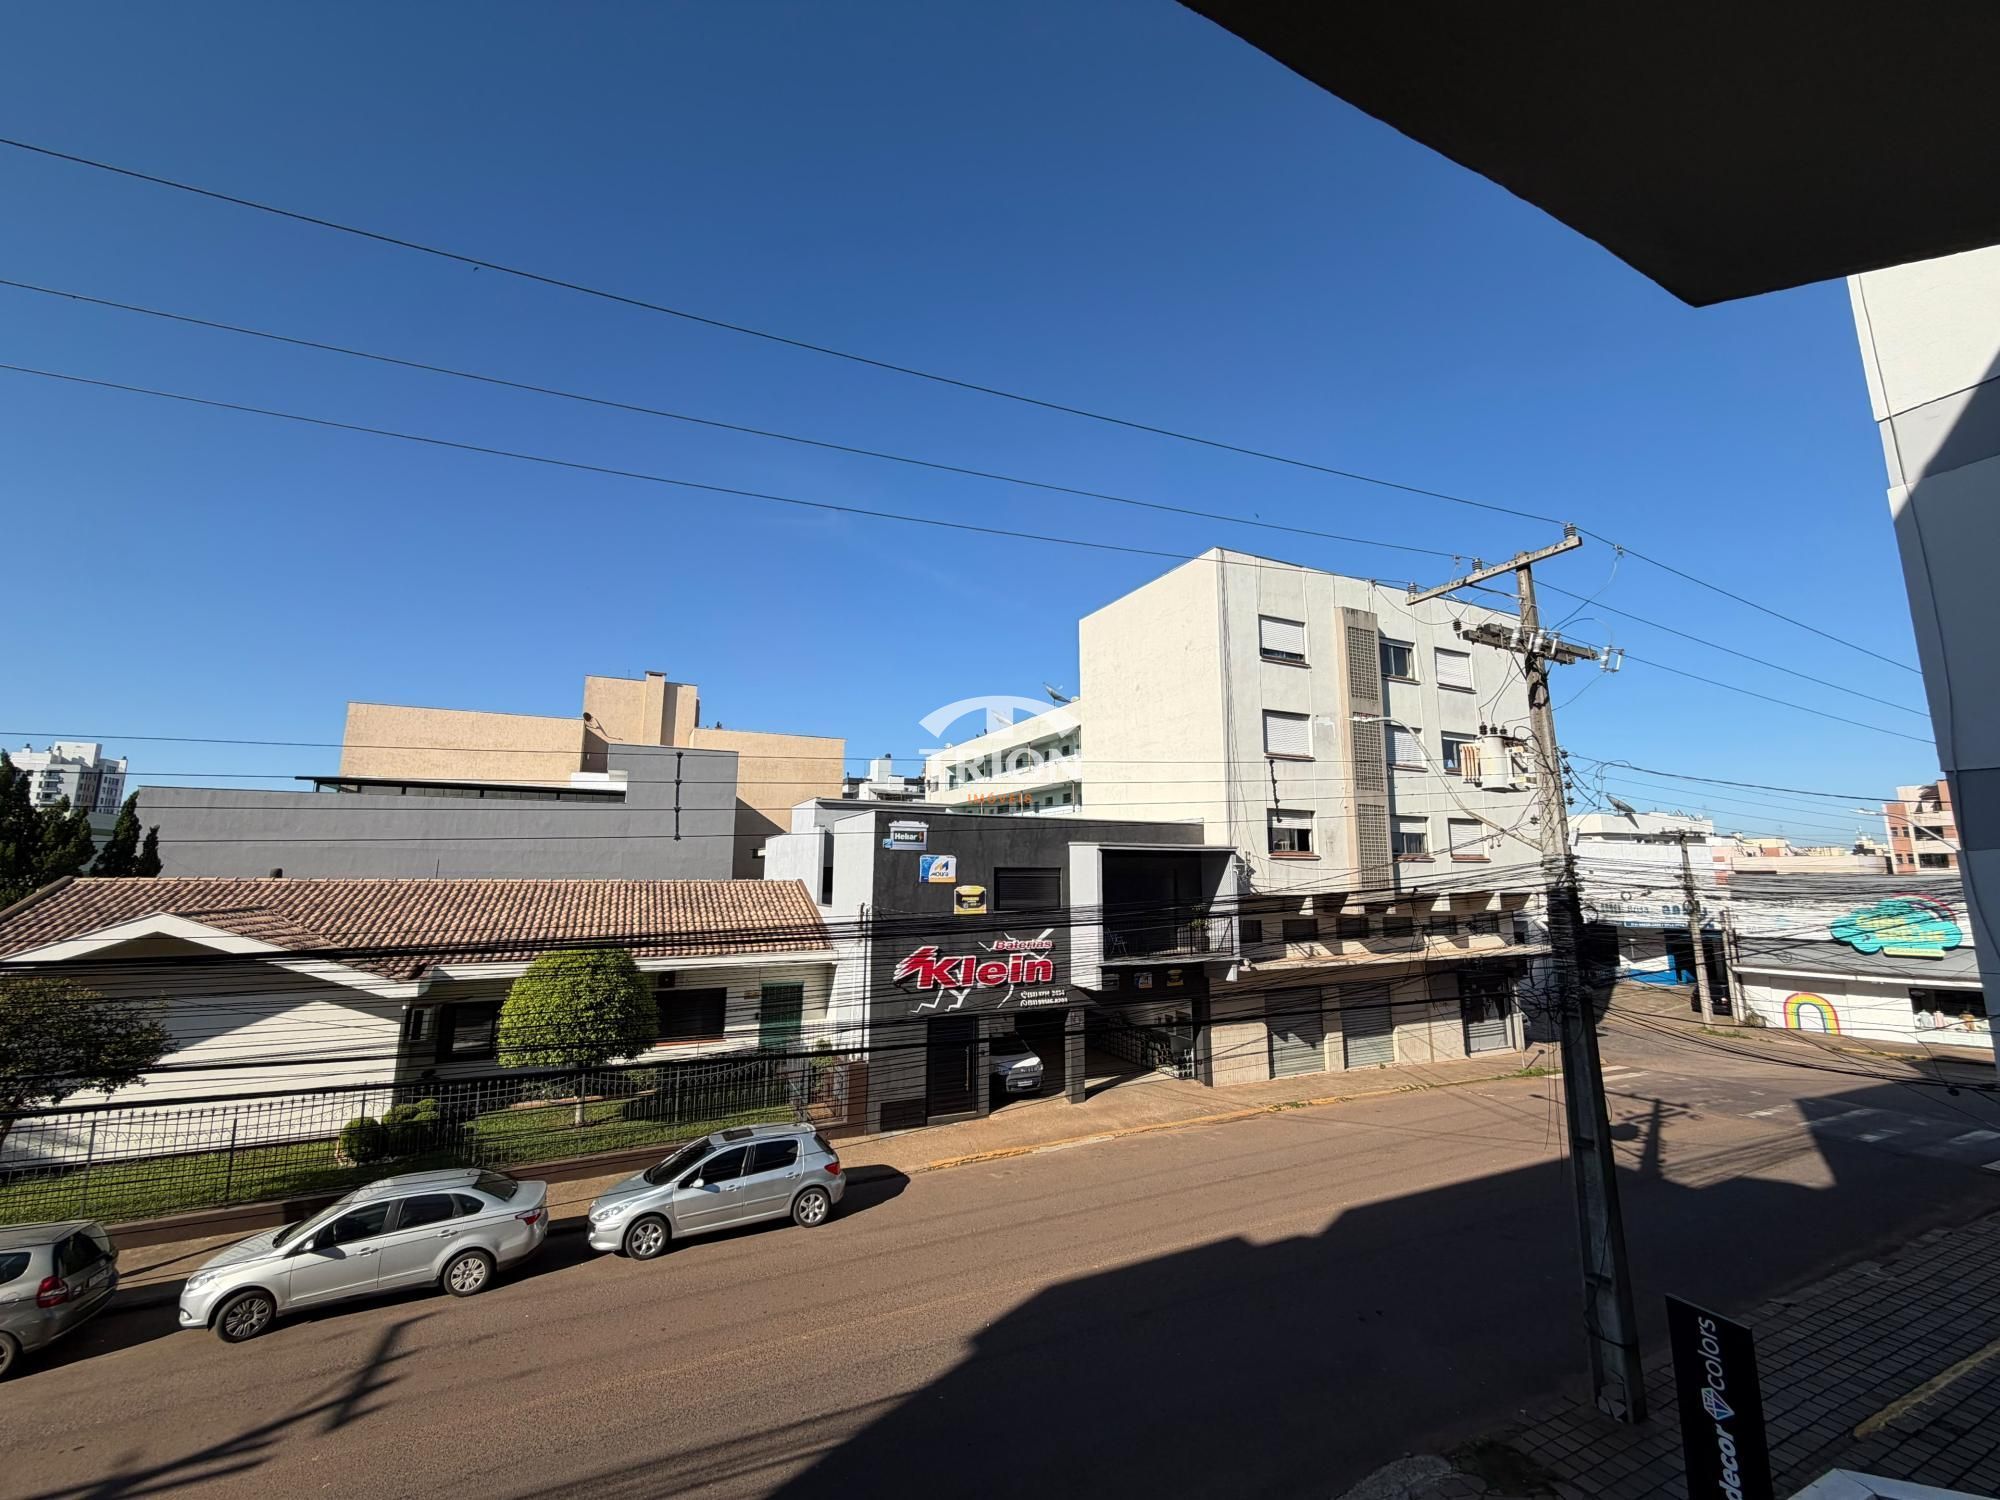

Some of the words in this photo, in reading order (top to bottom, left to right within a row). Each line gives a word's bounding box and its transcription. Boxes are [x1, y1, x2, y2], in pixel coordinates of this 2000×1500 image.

[900, 950, 1053, 990] Klein
[993, 939, 1053, 951] Baterias
[1697, 1316, 1726, 1391] colors
[1715, 1423, 1744, 1500] decor
